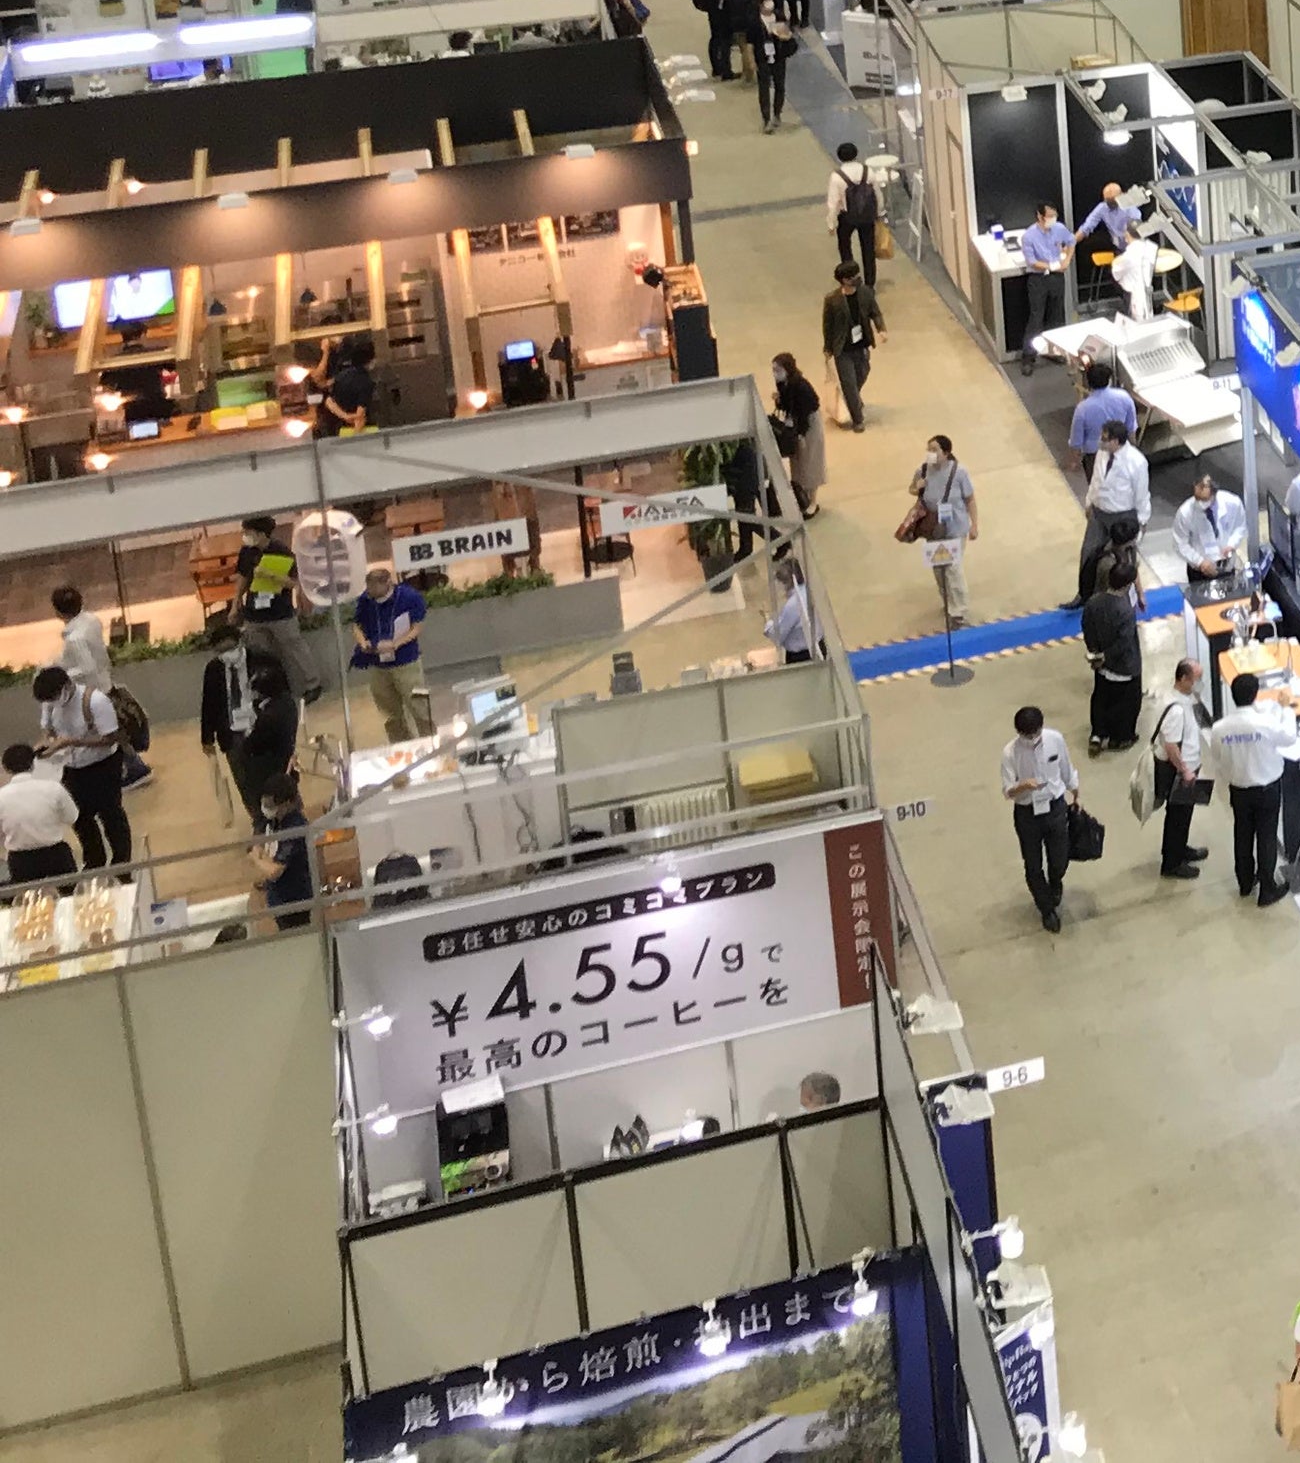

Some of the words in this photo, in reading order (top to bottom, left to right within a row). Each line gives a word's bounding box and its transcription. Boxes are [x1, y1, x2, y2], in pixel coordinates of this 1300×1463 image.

[440, 529, 513, 558] BRAIN
[896, 801, 927, 822] 9-10
[436, 869, 764, 957] お任せ安心のコミコミプラン
[436, 975, 790, 1085] 最高のコーヒーを
[1002, 1066, 1029, 1087] 9-6
